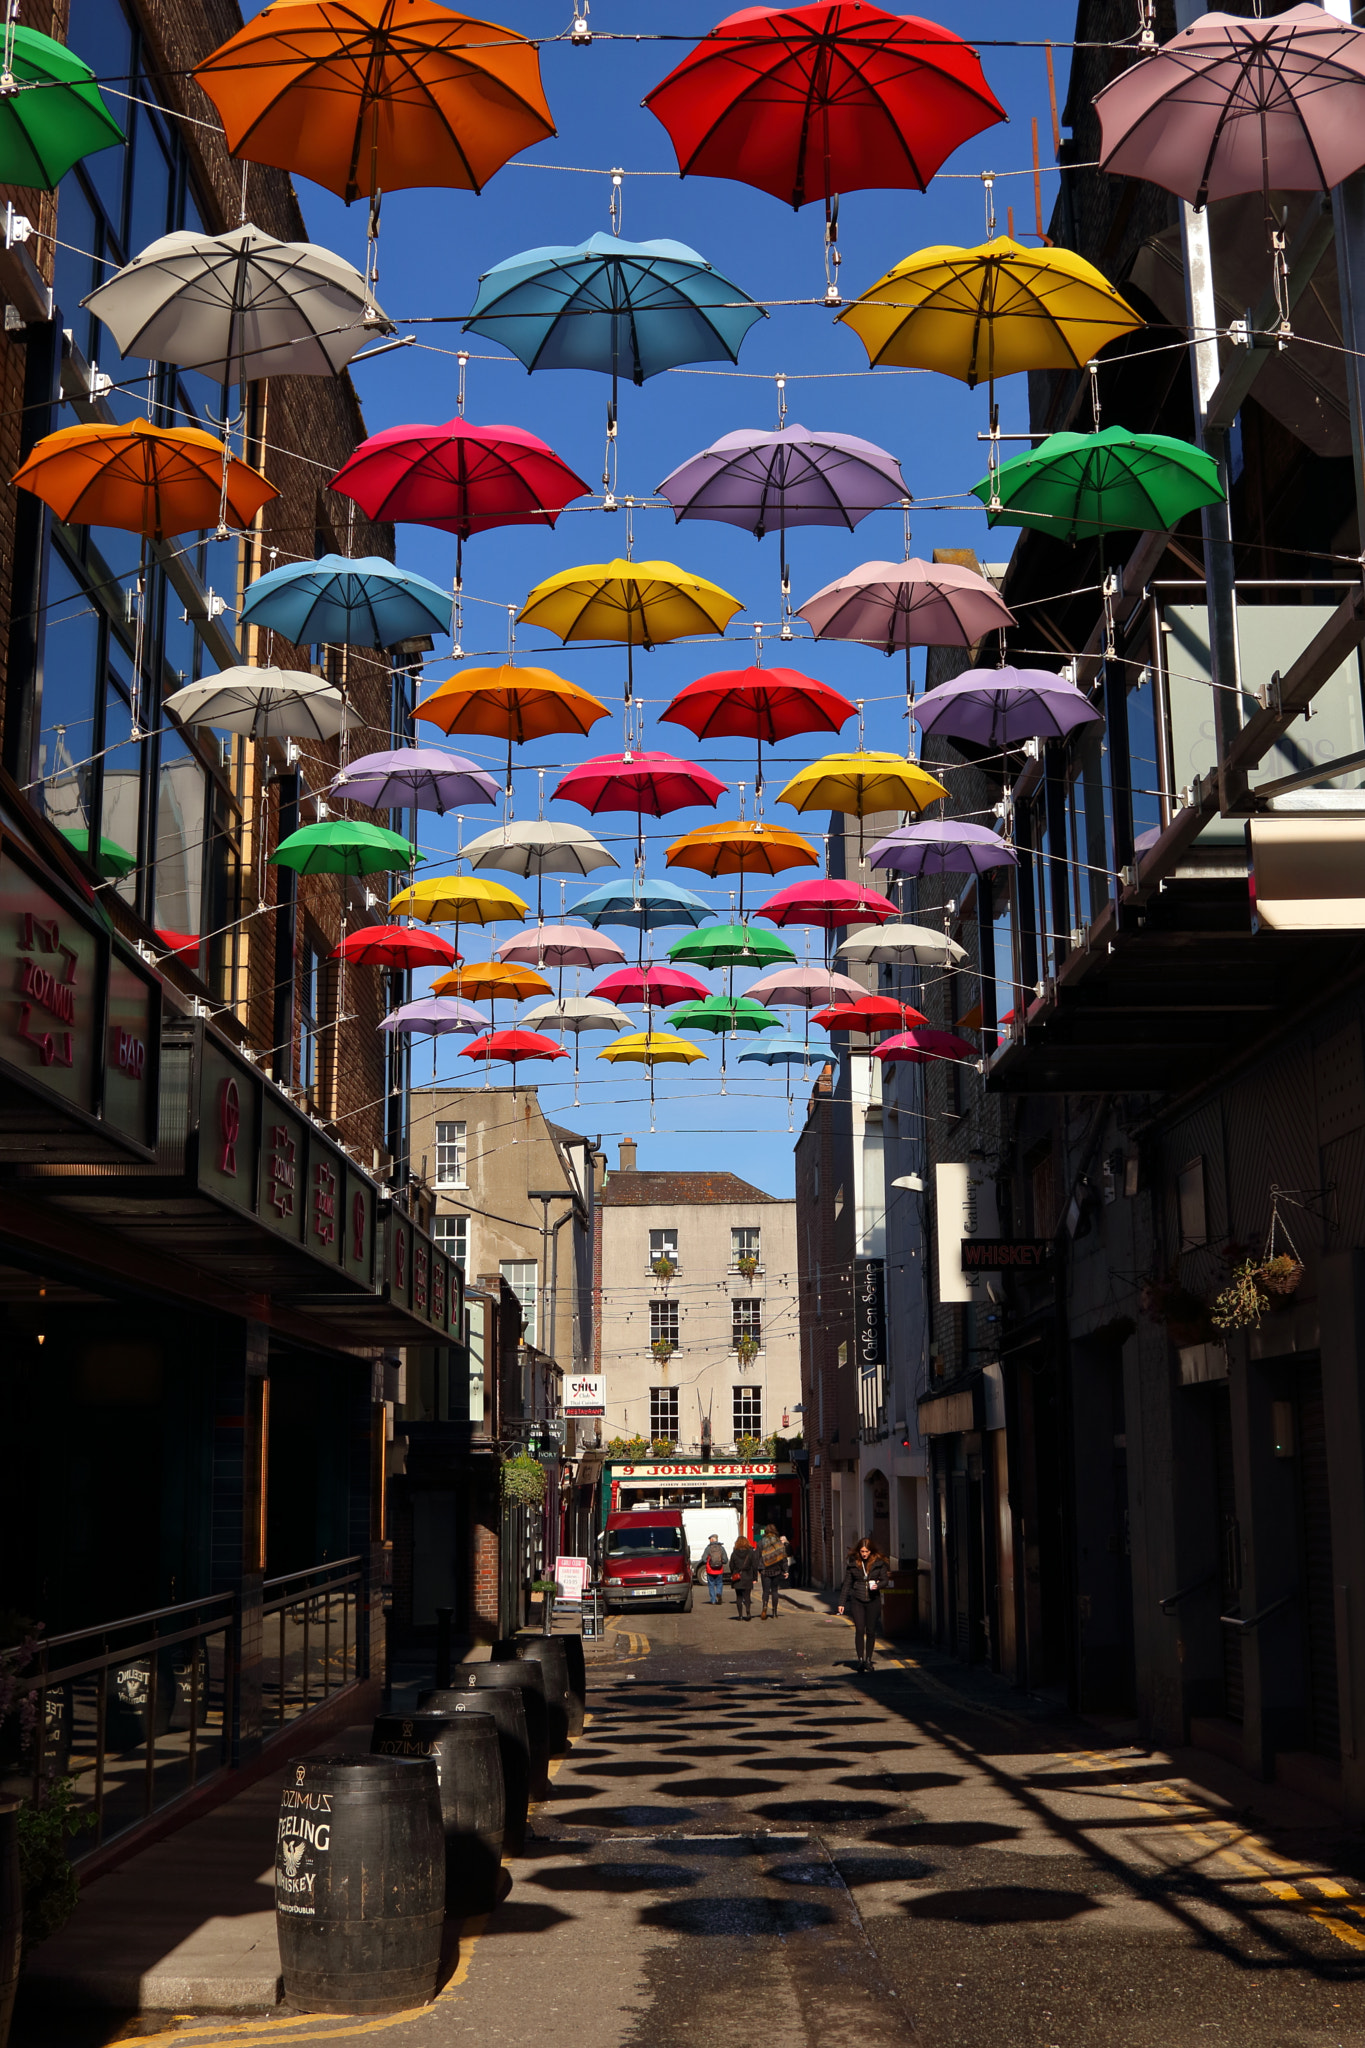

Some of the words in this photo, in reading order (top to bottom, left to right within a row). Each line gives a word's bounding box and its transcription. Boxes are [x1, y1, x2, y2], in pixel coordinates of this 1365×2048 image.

[115, 1027, 145, 1079] BAR
[962, 1175, 978, 1234] Gallery
[963, 1244, 1044, 1265] WHISKEY
[862, 1263, 878, 1305] Seine
[866, 1307, 878, 1326] en
[861, 1328, 878, 1361] Café
[571, 1383, 598, 1392] CHILI
[623, 1465, 635, 1475] 9
[647, 1465, 702, 1475] JOHN
[713, 1464, 779, 1475] KEHOE
[277, 1815, 331, 1851] TEELING
[276, 1867, 317, 1894] WHISKEY
